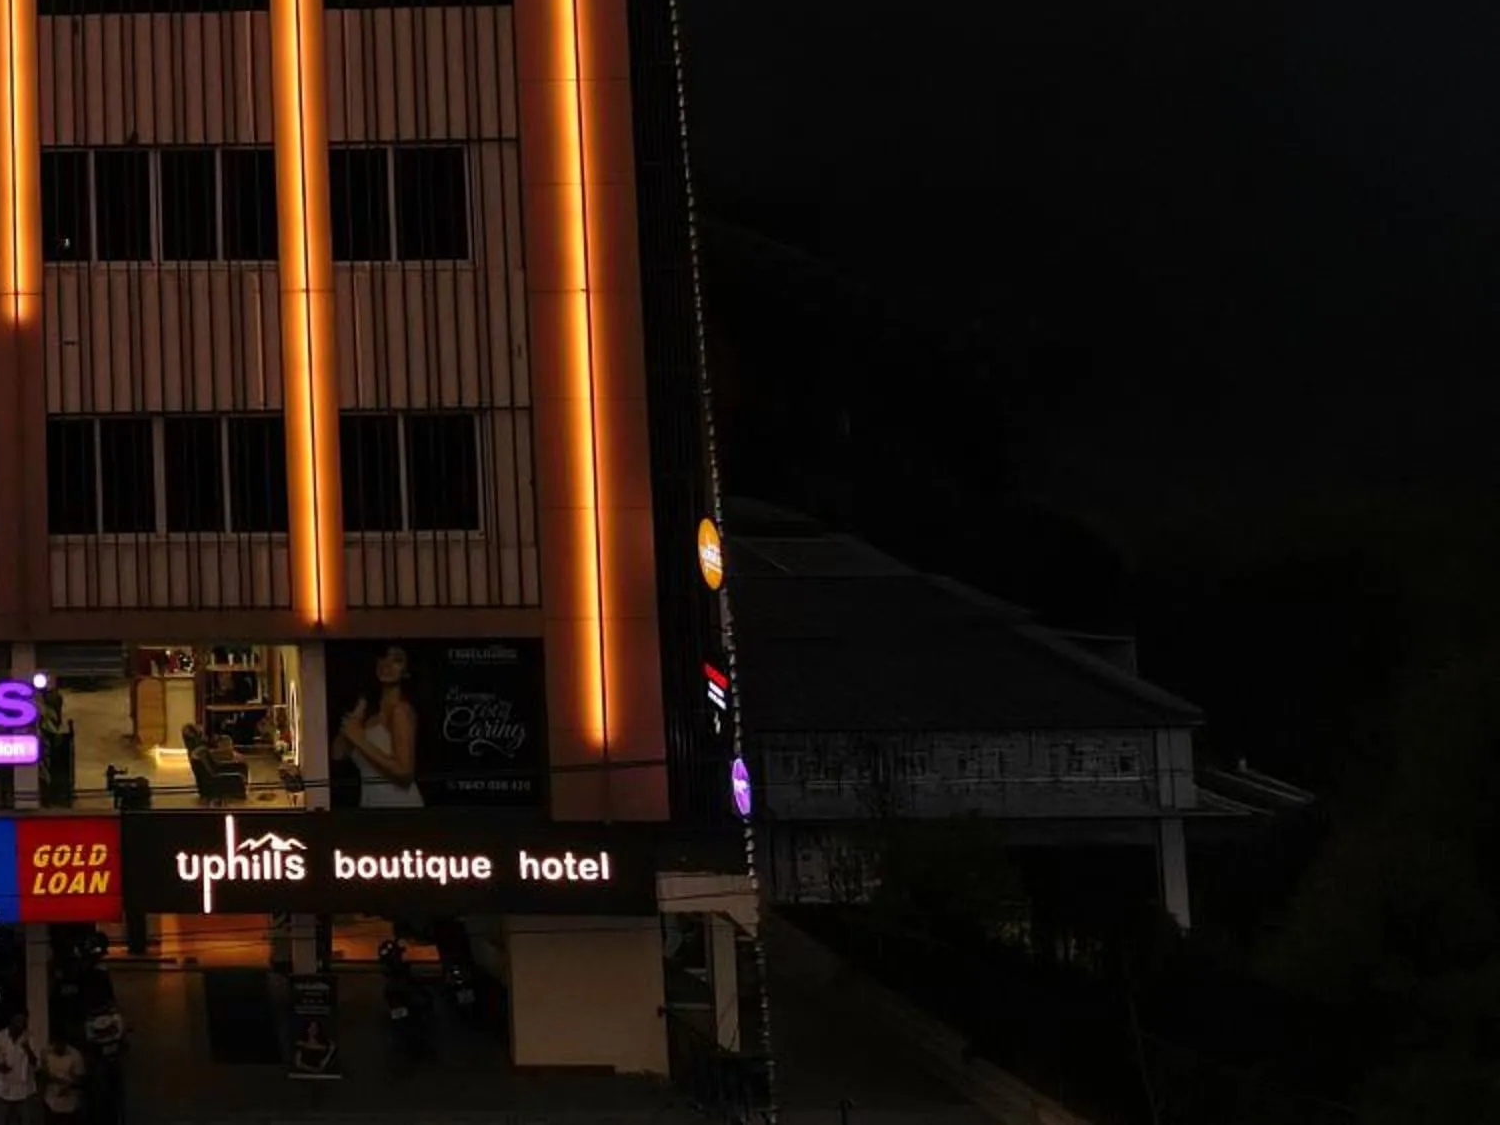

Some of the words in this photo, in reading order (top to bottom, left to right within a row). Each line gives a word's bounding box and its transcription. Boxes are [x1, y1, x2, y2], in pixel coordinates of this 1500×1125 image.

[33, 844, 107, 868] GOLD
[176, 815, 307, 914] uphills
[334, 849, 491, 885] boutique
[519, 851, 610, 880] hotel
[33, 871, 111, 894] LOAN
